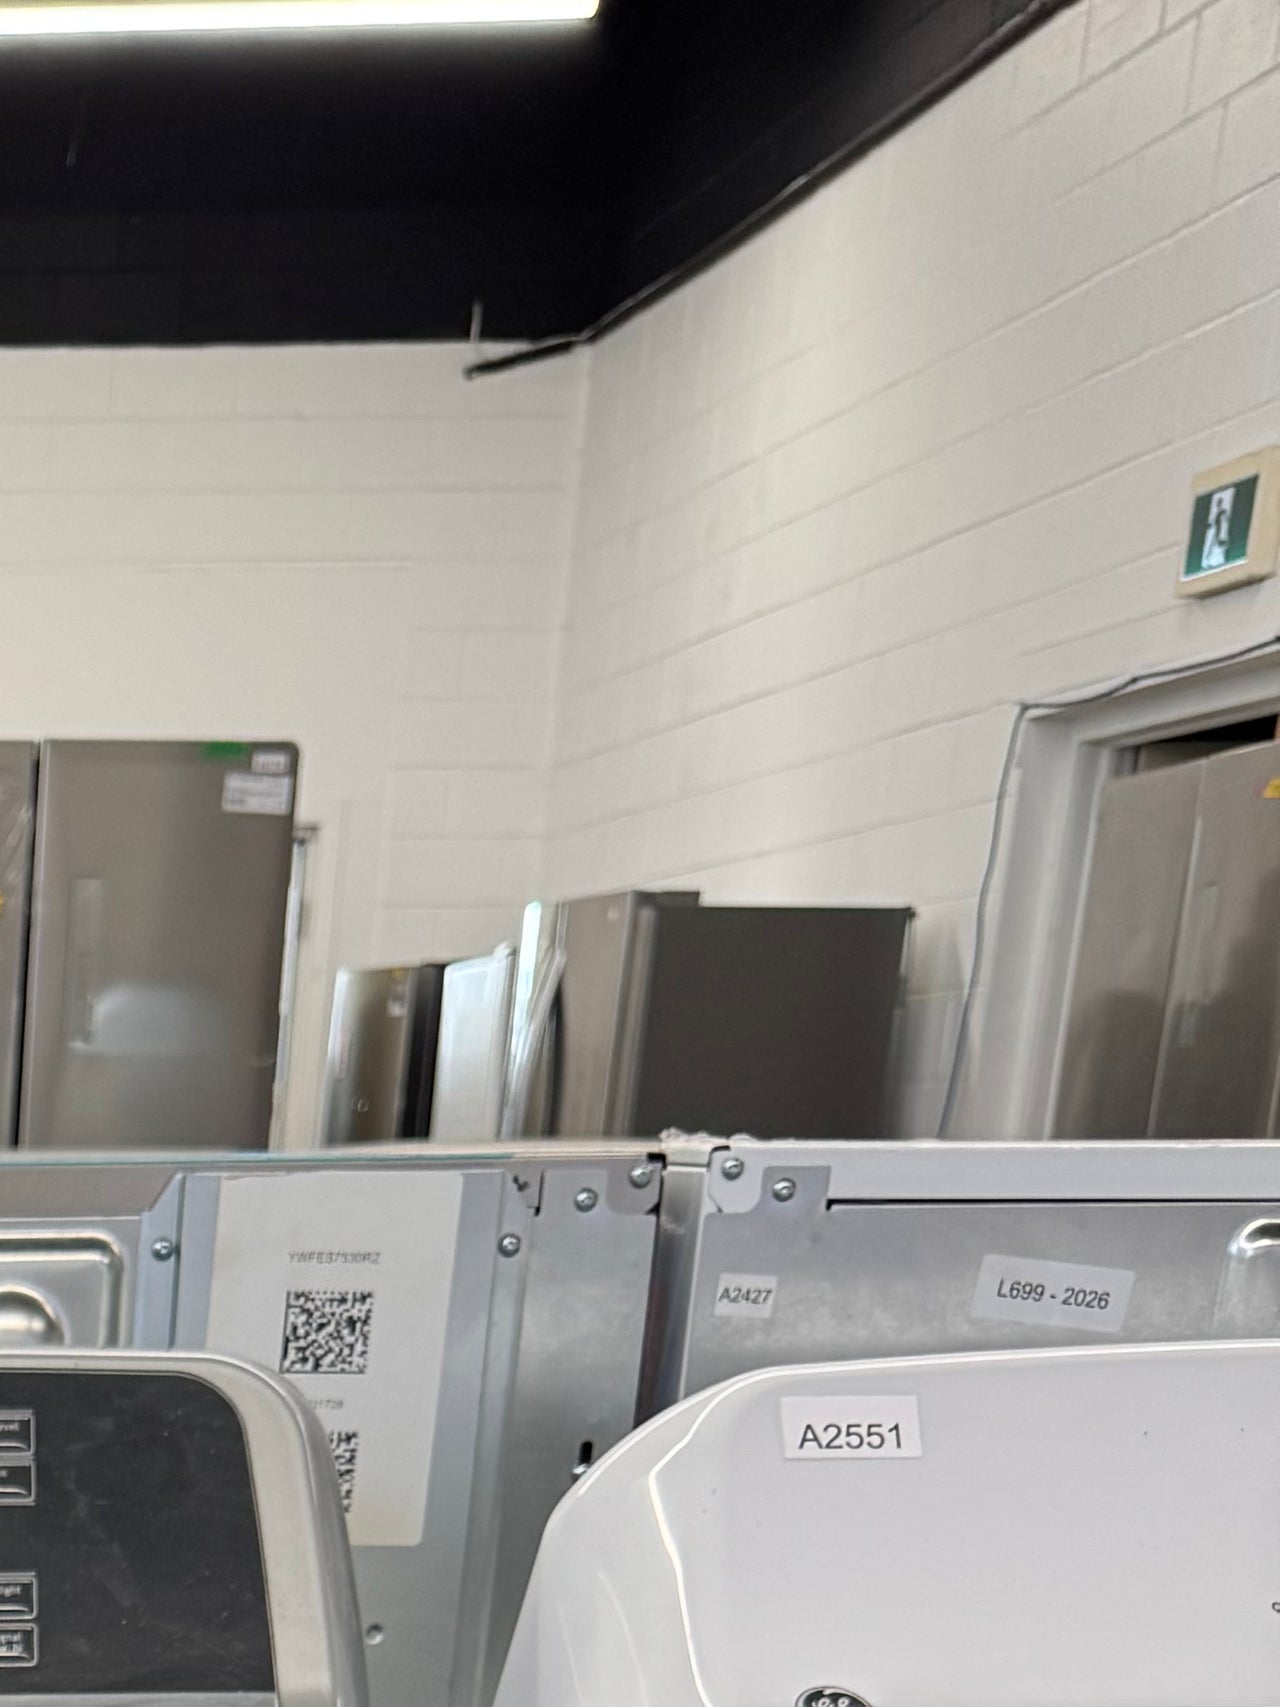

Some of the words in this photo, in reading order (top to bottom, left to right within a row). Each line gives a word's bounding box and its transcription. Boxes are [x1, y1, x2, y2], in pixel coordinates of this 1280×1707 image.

[718, 1286, 772, 1305] A2427
[997, 1278, 1045, 1303] L699
[1061, 1286, 1111, 1310] 2026
[798, 1423, 903, 1450] A2551
